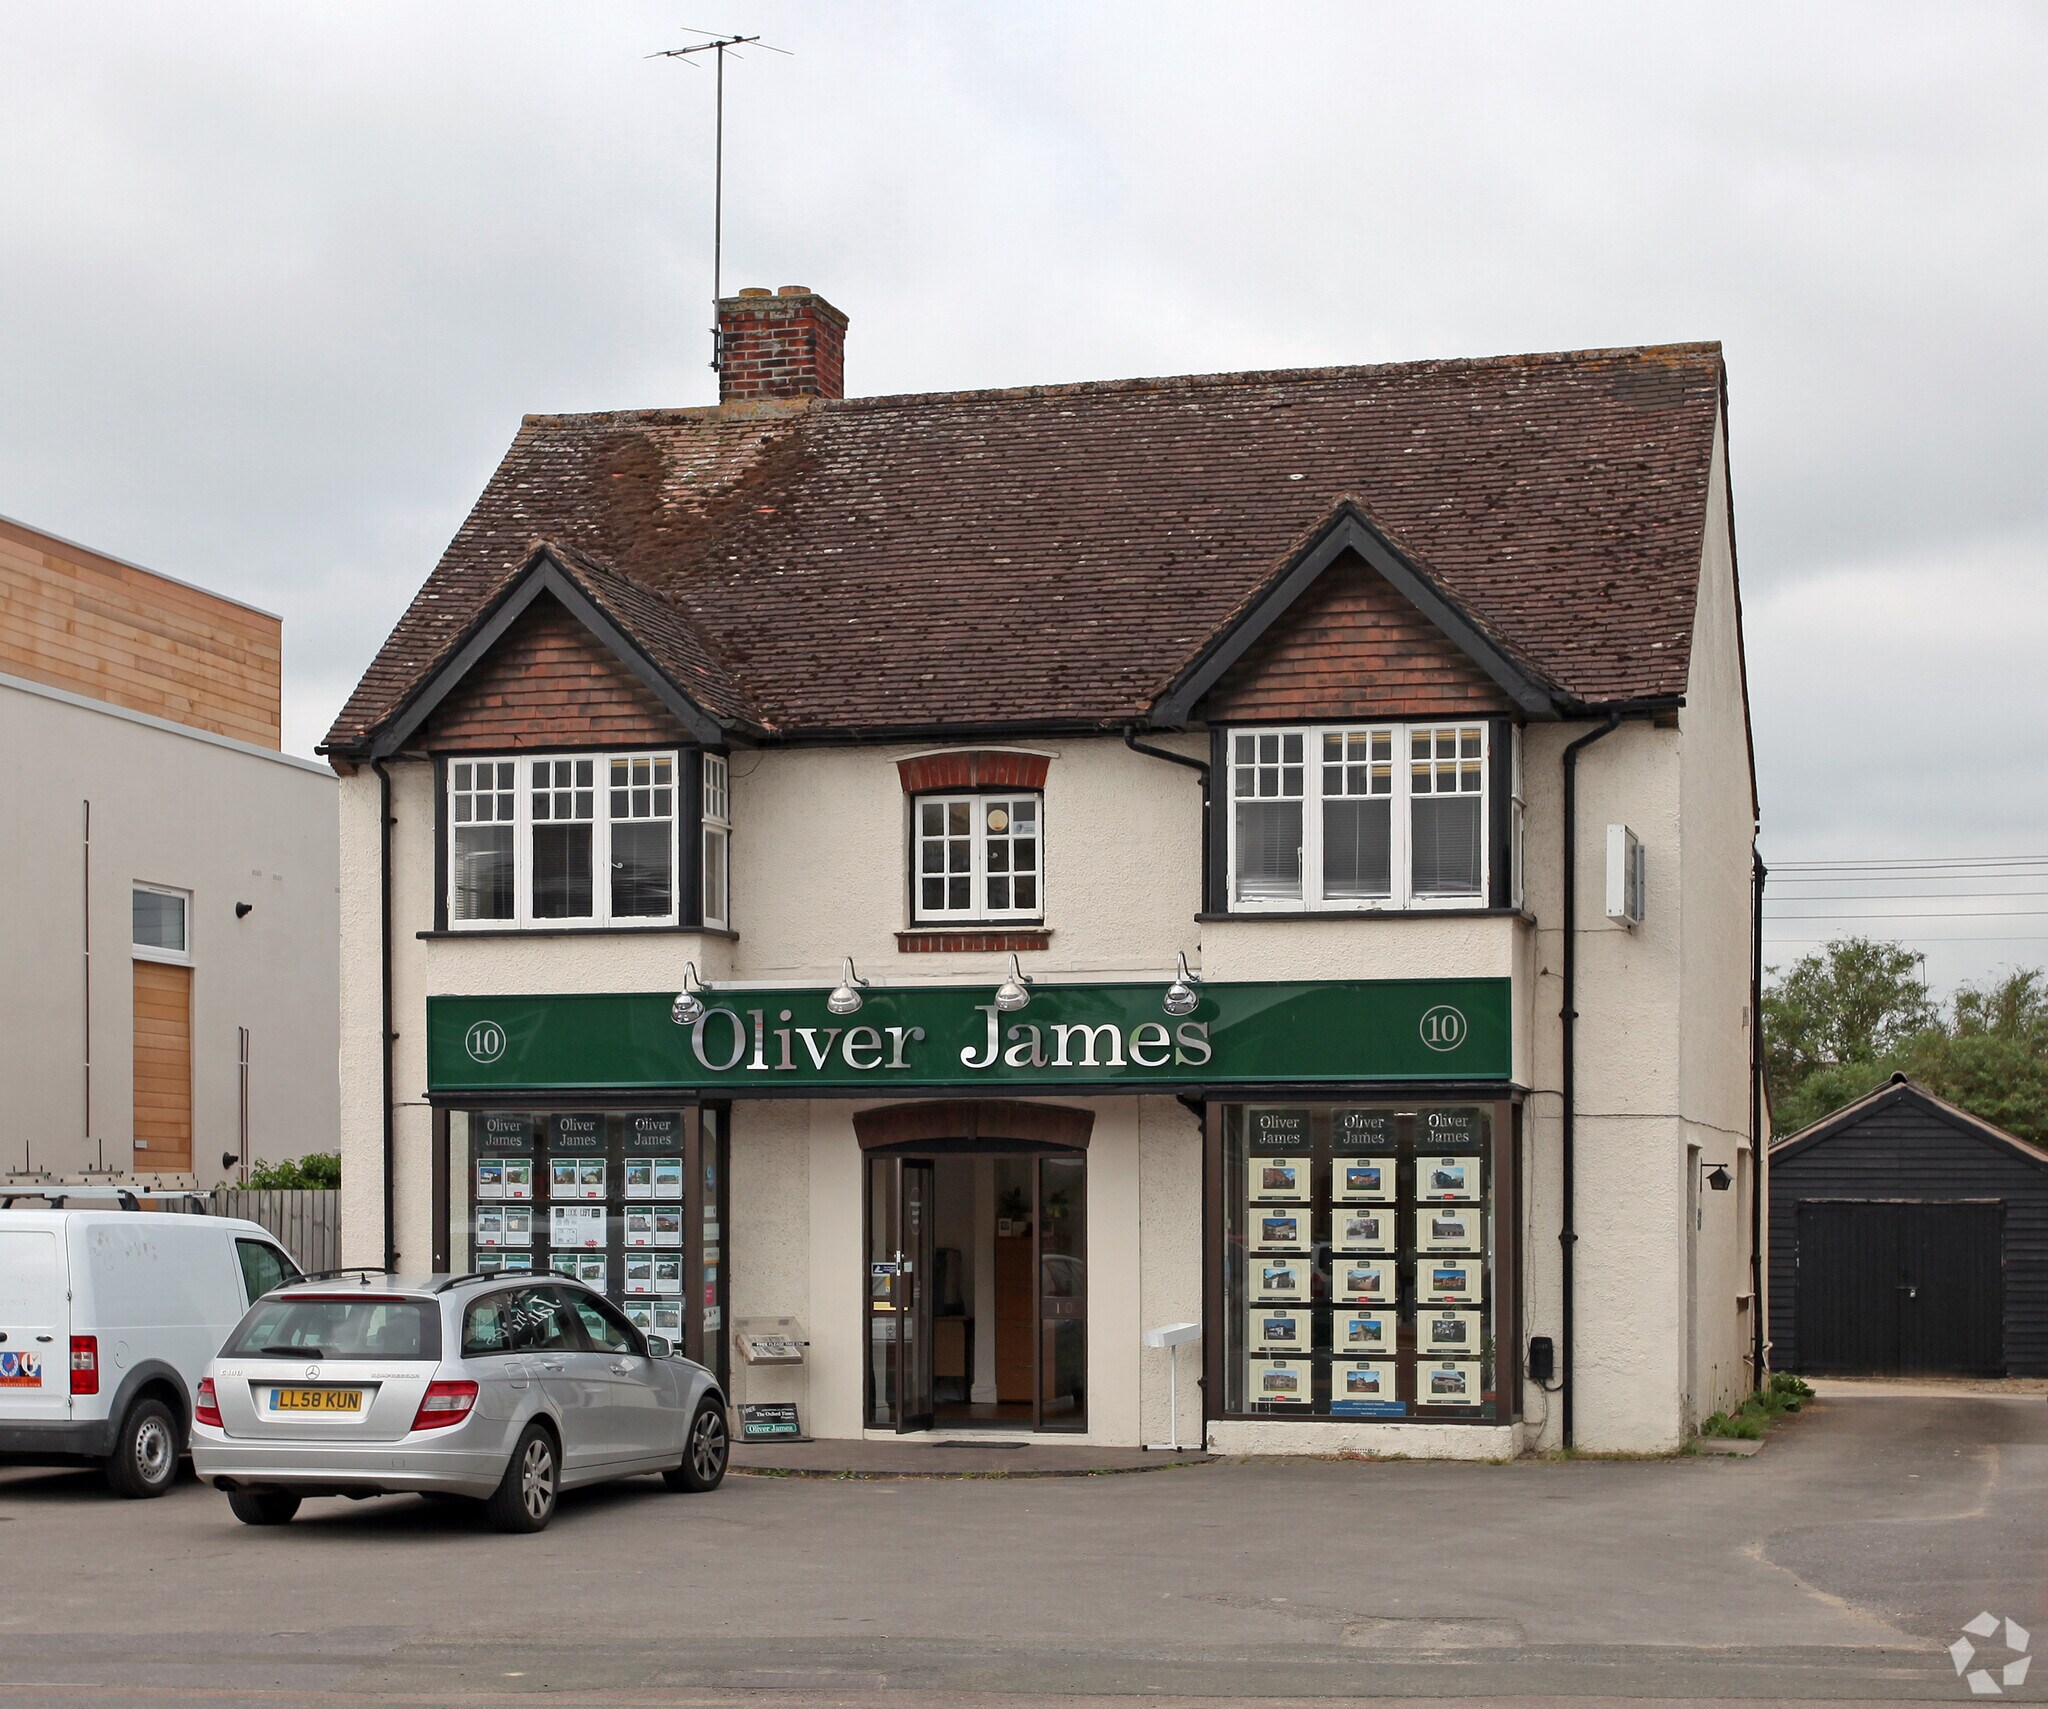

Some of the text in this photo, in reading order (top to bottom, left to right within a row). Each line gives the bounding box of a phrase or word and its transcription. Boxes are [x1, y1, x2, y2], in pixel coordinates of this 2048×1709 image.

[1427, 1014, 1459, 1042] 10
[471, 1028, 499, 1056] 10
[691, 1004, 1214, 1072] Oliver James
[486, 1117, 522, 1133] Oliver
[559, 1117, 596, 1132] Oliver
[634, 1117, 672, 1132] Oliver
[1259, 1114, 1300, 1129] Oliver
[1344, 1114, 1385, 1129] Oliver
[1427, 1112, 1469, 1128] Oliver
[485, 1133, 523, 1147] James
[559, 1133, 597, 1147] James
[634, 1132, 672, 1146] James
[1258, 1131, 1301, 1145] James
[1343, 1131, 1385, 1145] James
[1426, 1129, 1469, 1144] James
[279, 1391, 359, 1410] LL58 KUN
